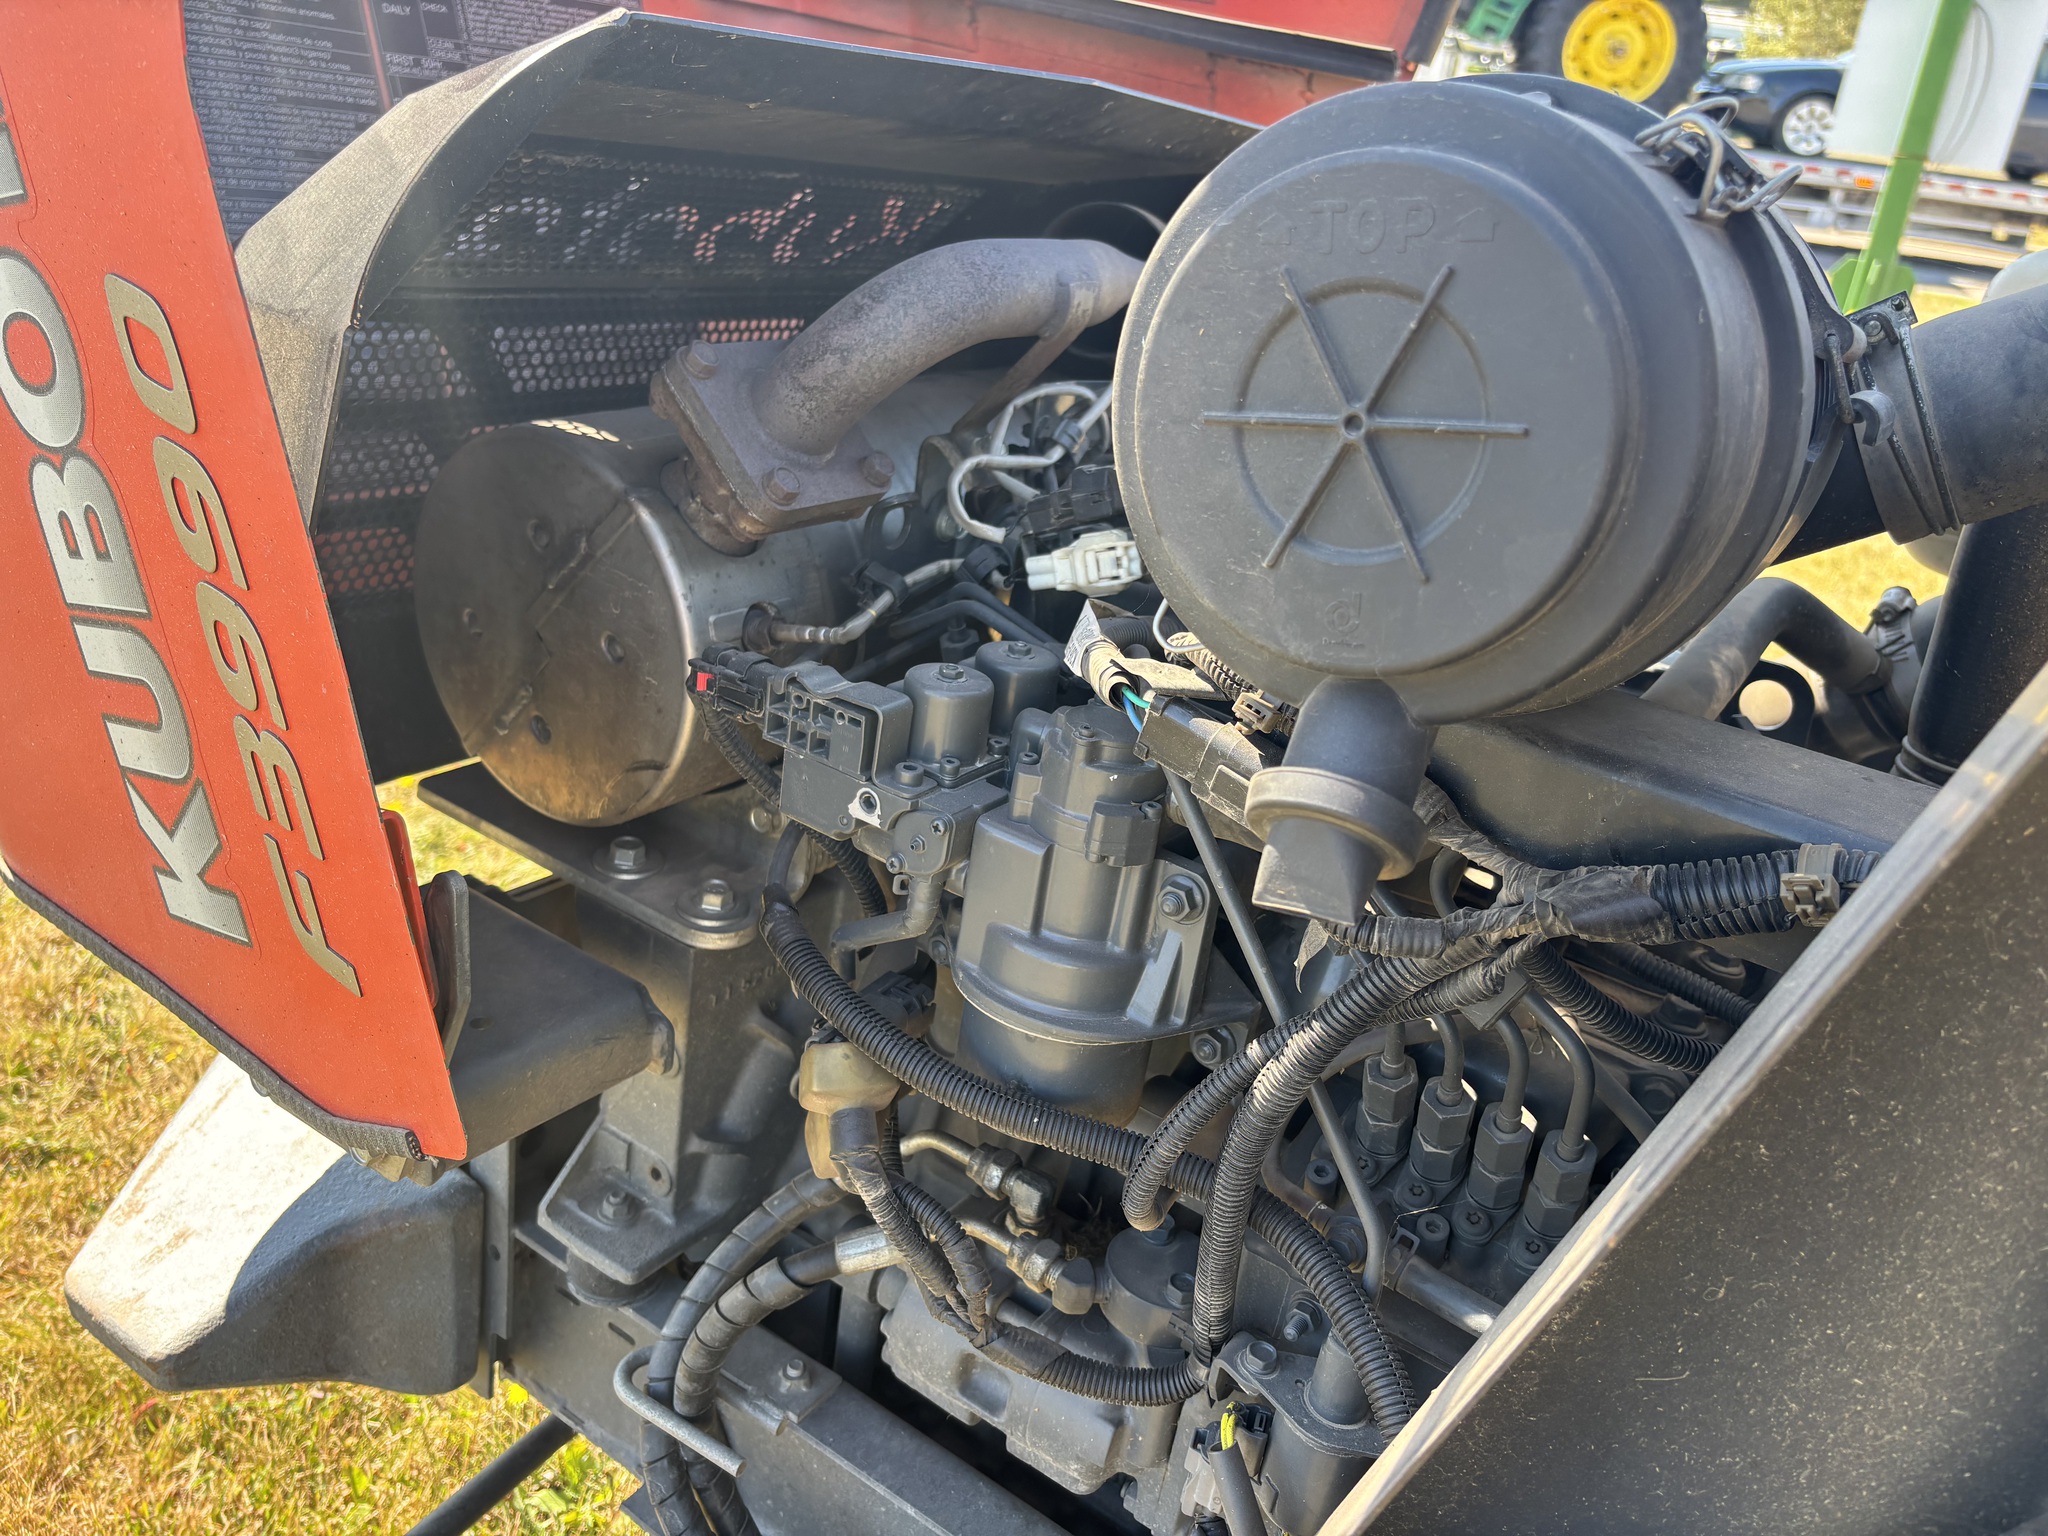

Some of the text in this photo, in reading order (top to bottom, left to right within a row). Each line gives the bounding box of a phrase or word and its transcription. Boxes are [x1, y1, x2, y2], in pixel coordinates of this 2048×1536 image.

[381, 2, 411, 16] DAILY
[385, 53, 415, 67] FIRST
[1309, 202, 1437, 256] TOP
[0, 122, 253, 947] KUBO
[103, 272, 363, 999] F3990
